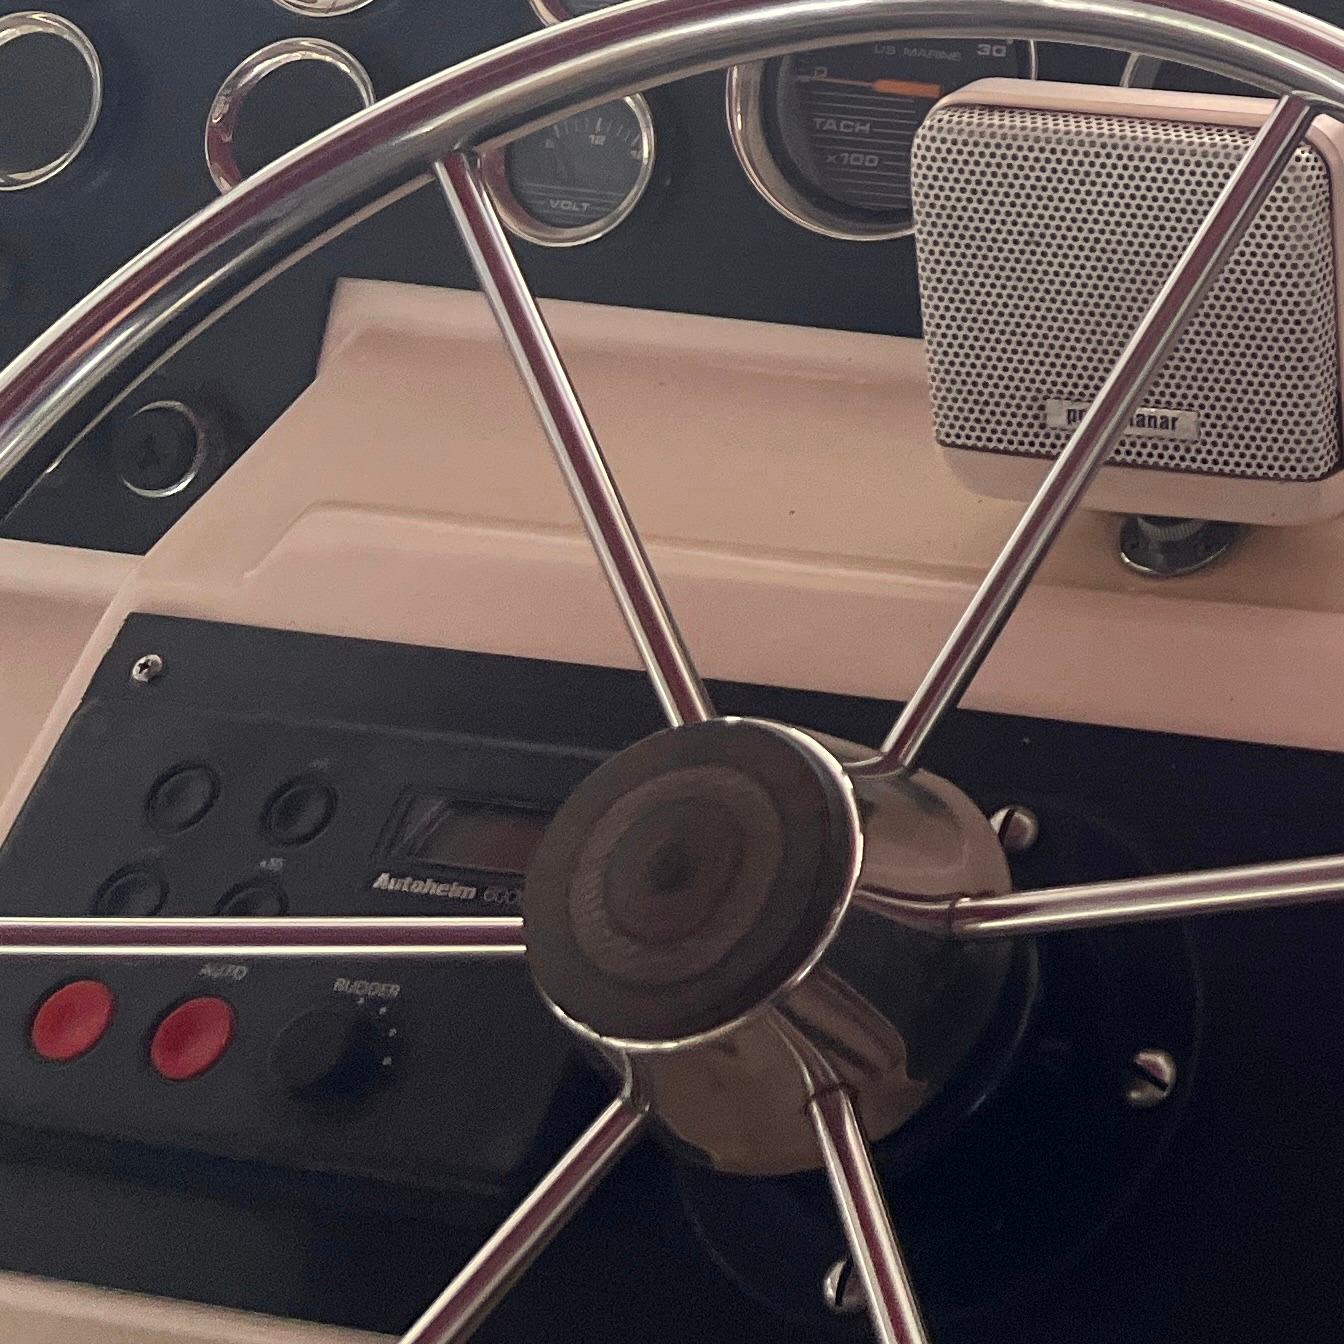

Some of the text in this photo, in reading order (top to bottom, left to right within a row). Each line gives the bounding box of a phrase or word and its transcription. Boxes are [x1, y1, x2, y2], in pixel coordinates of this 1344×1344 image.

[903, 46, 962, 62] MARINE
[976, 43, 1007, 58] 30
[813, 117, 871, 134] TACH
[549, 198, 590, 212] VOLT
[199, 962, 249, 982] AUTO
[333, 976, 401, 999] RUDDER
